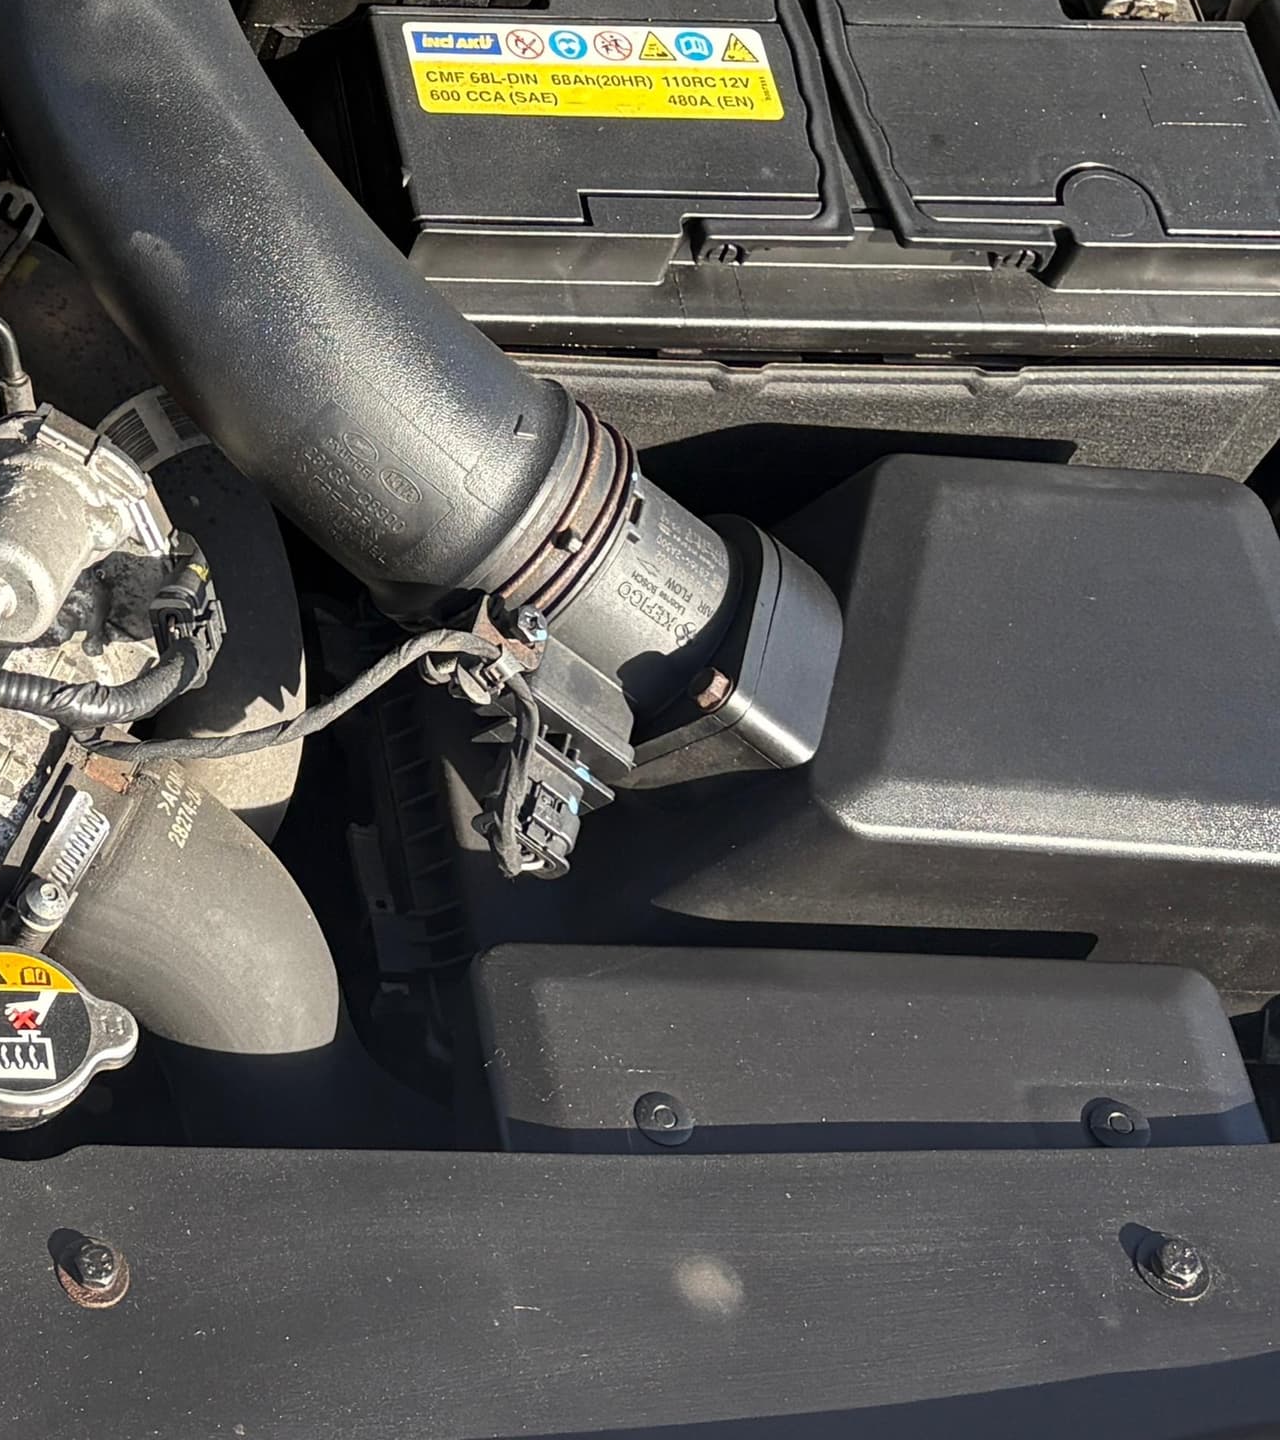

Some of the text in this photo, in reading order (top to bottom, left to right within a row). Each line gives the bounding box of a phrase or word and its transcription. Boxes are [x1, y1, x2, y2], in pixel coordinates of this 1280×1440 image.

[425, 70, 465, 83] CMF
[470, 72, 538, 85] 68L-DIN
[551, 74, 653, 90] 68Ah(20HR)
[662, 75, 717, 88] 110RC
[720, 76, 750, 89] 12V
[430, 89, 558, 106] 600 CCA (SAE)
[668, 95, 755, 110] 480A (EN)
[631, 570, 658, 594] BOSCH
[665, 576, 693, 602] FLOW
